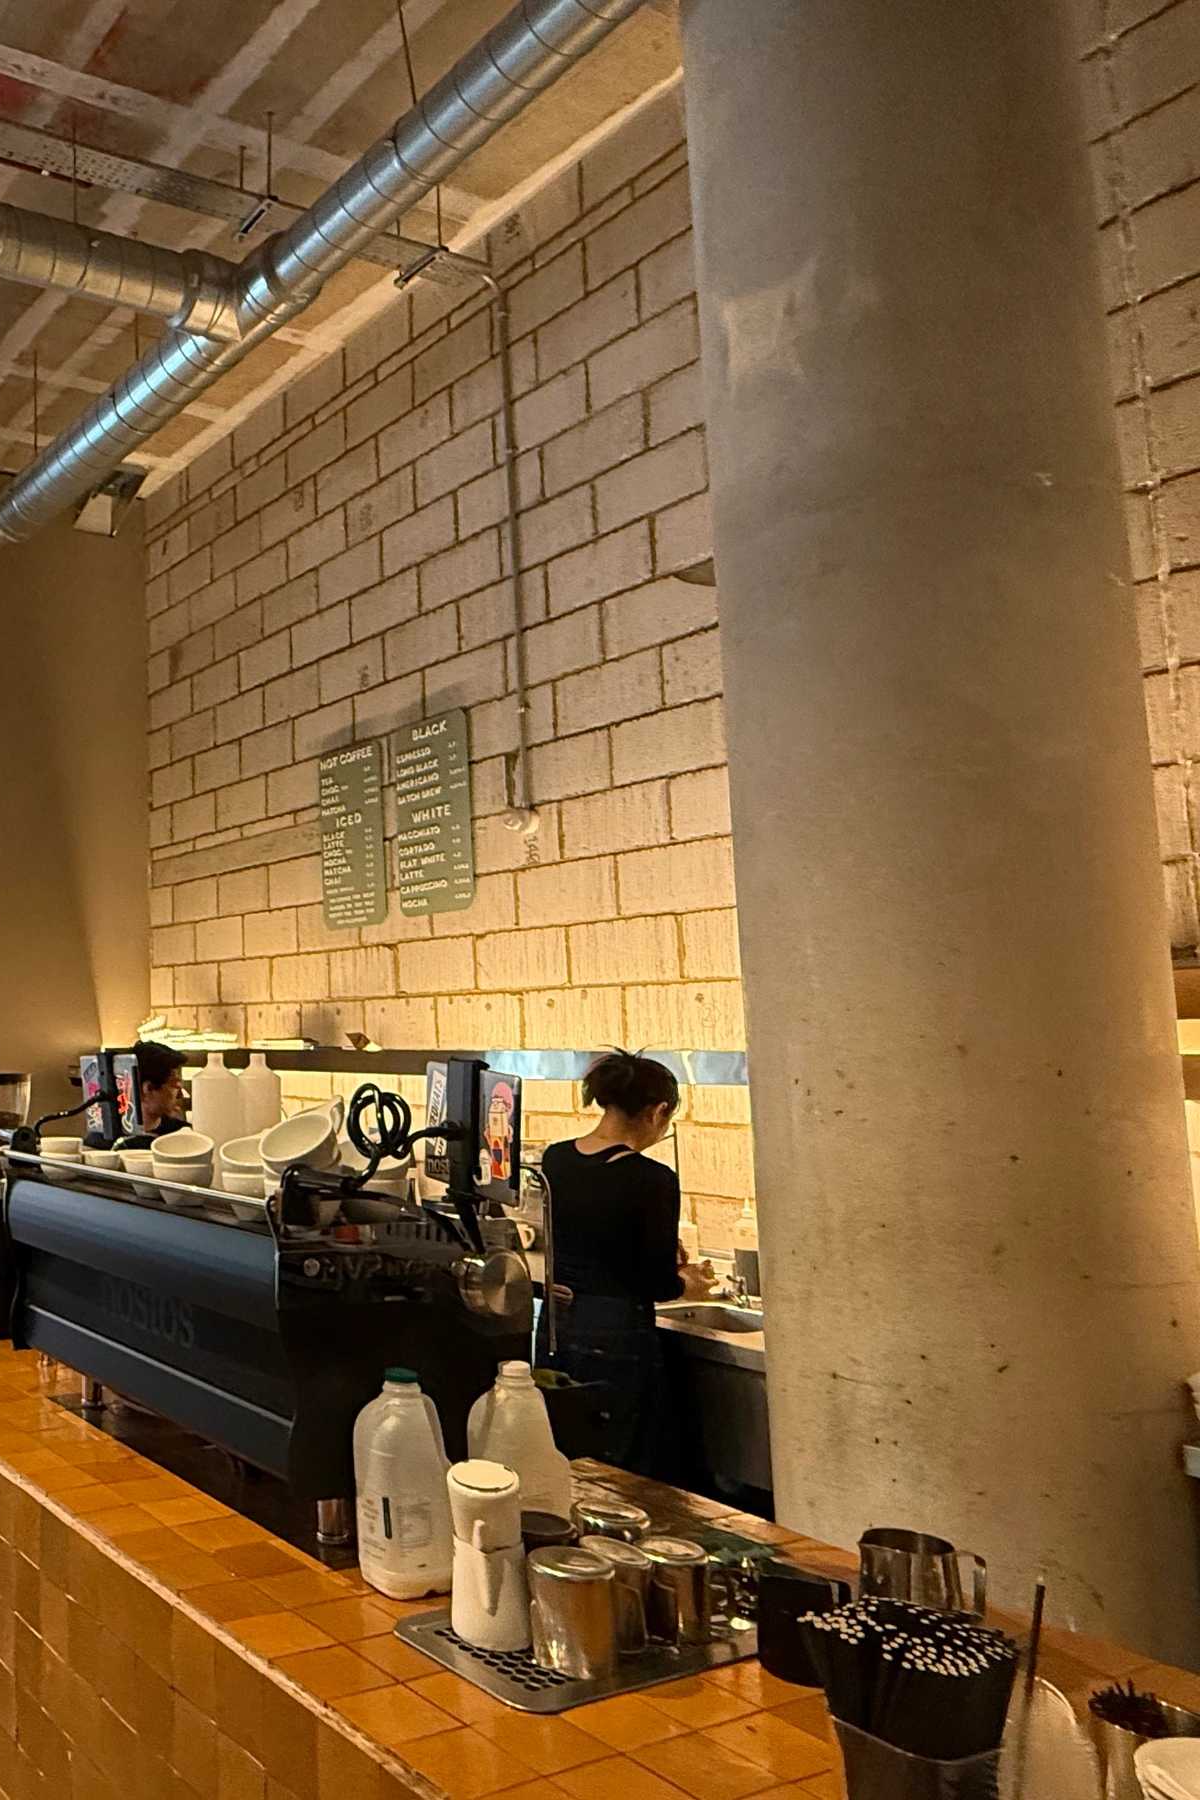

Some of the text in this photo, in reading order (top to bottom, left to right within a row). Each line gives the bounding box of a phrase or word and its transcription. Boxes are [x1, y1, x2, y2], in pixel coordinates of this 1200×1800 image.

[411, 720, 447, 741] BLACK
[340, 746, 373, 765] COFFEE
[396, 747, 431, 764] ESPRESSO
[397, 765, 415, 778] LONG
[416, 758, 439, 773] BLACK
[396, 772, 440, 791] AMERICANO
[397, 791, 420, 805] BATCH
[421, 785, 442, 799] BREW
[336, 812, 362, 828] ICED
[411, 804, 451, 823] WHITE
[323, 831, 345, 843] BLACK
[398, 825, 441, 842] MACCHIATO
[323, 840, 344, 850] LATTE
[399, 842, 435, 857] CORTADO
[324, 856, 347, 867] MOCHA
[400, 858, 417, 870] FLAT
[420, 853, 446, 866] WHITE
[324, 865, 353, 876] MATCHA
[400, 869, 424, 881] LATTE
[324, 876, 341, 886] CHAI
[400, 879, 448, 895] CAPPUCCINO
[402, 898, 428, 909] MOCHA
